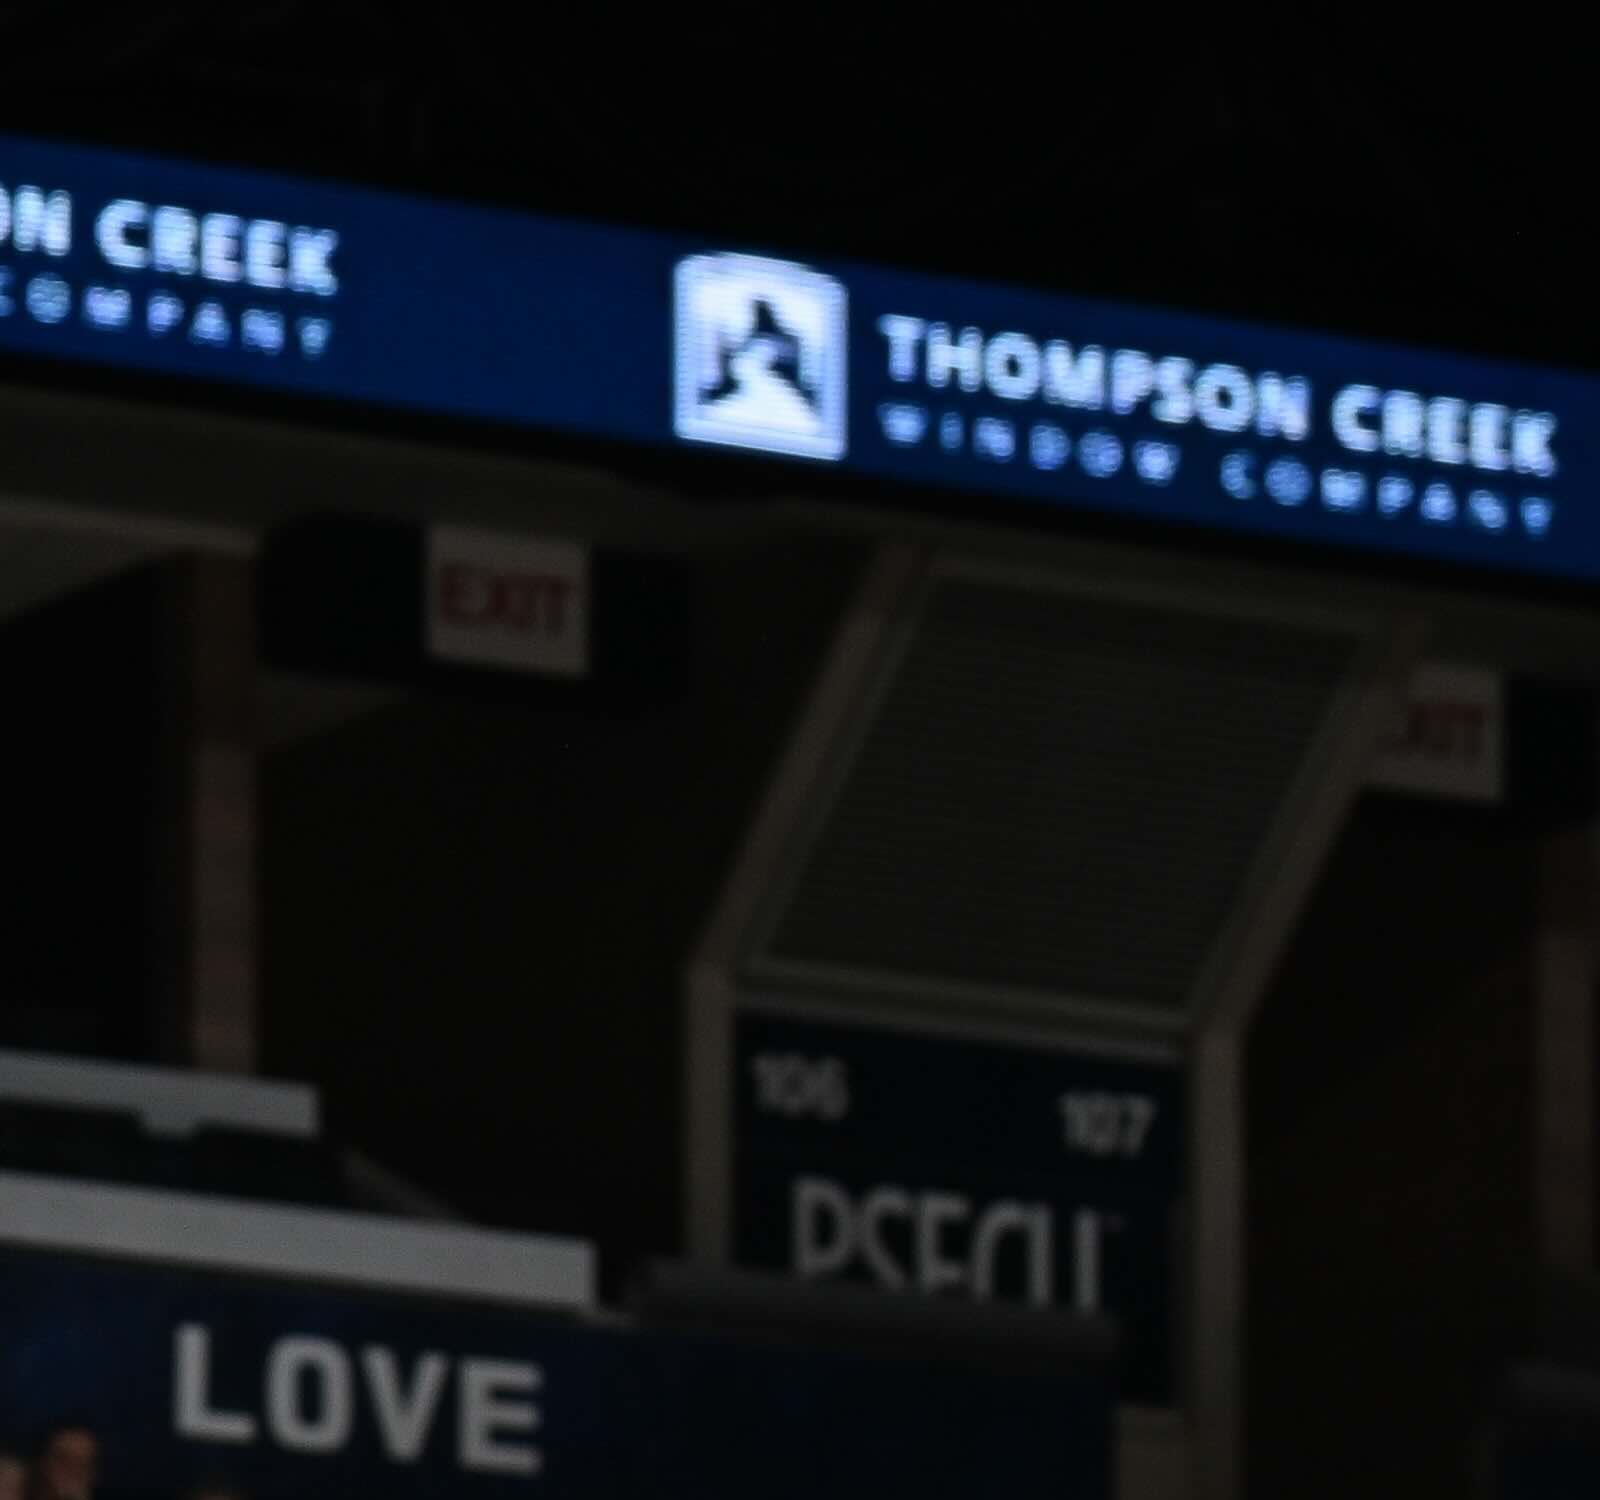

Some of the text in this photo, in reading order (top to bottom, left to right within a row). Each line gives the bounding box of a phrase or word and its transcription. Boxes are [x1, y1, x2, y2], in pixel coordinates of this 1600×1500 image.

[95, 198, 340, 297] CREEK
[879, 314, 1558, 477] THOMPSON CREEK
[876, 403, 1554, 538] WINDOW COMPANY
[438, 560, 573, 640] EXIT
[172, 1322, 545, 1477] LOVE
